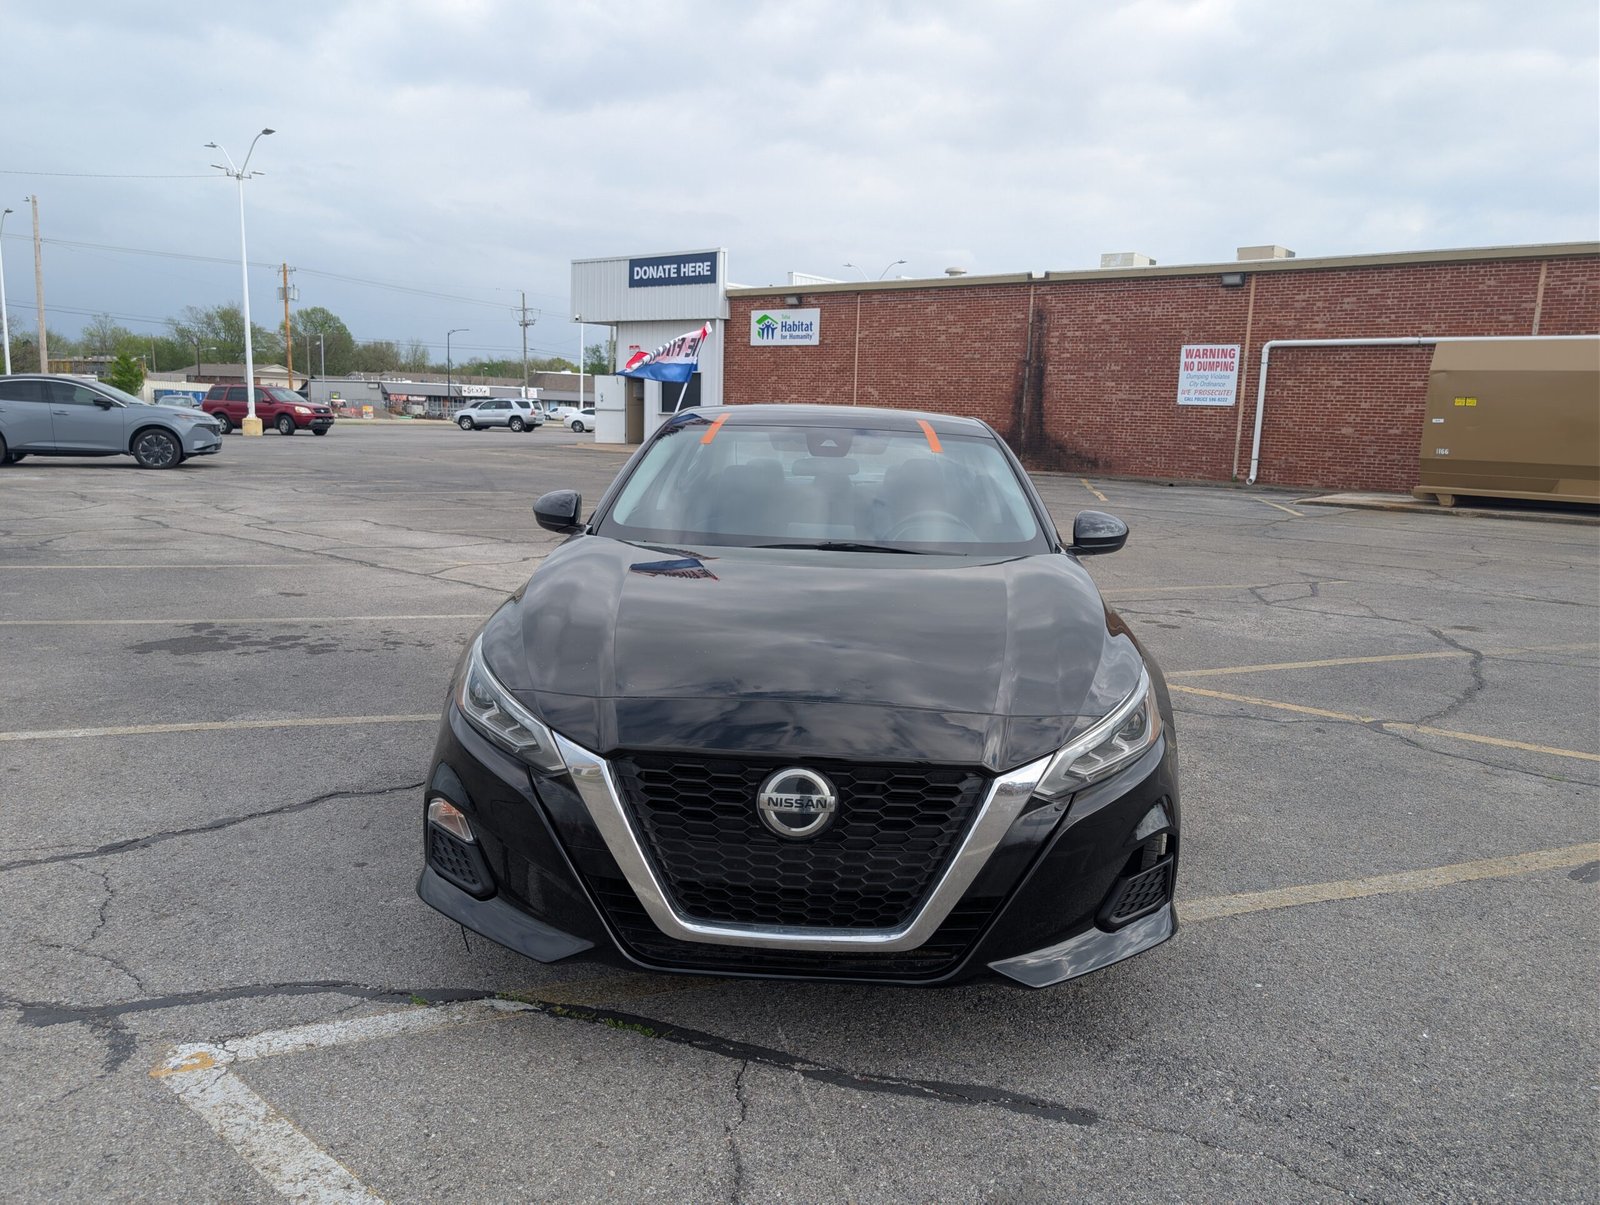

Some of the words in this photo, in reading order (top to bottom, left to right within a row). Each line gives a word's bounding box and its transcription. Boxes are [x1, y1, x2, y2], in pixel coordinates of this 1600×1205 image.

[633, 263, 678, 280] DONATE
[680, 261, 711, 276] HERE
[780, 320, 813, 332] Habitat
[788, 333, 813, 341] Humanity
[1185, 348, 1236, 359] WARNING
[1184, 361, 1195, 372] NO
[1197, 361, 1235, 372] DUMPING
[767, 796, 827, 809] NISSAN
